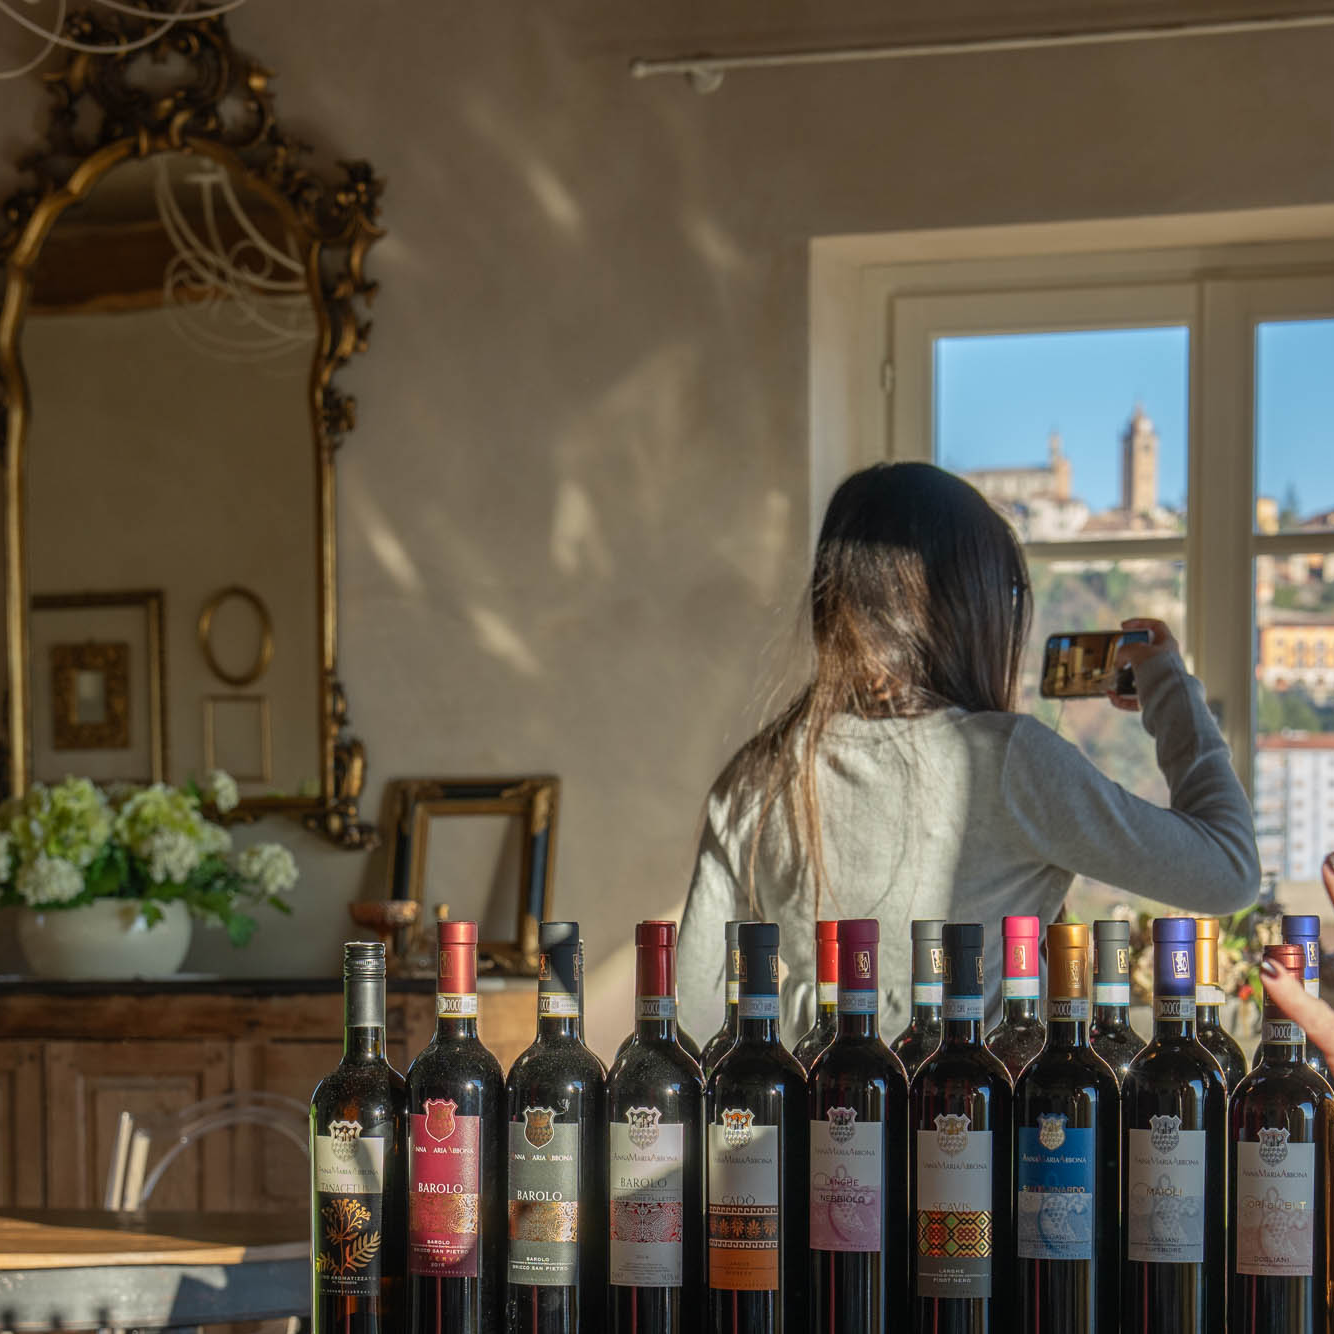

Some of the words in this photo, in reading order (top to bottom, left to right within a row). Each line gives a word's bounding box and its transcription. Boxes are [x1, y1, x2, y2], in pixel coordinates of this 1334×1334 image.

[418, 1182, 464, 1194] BAROLO
[620, 1177, 667, 1188] BAROLO
[517, 1190, 563, 1202] BAROLO
